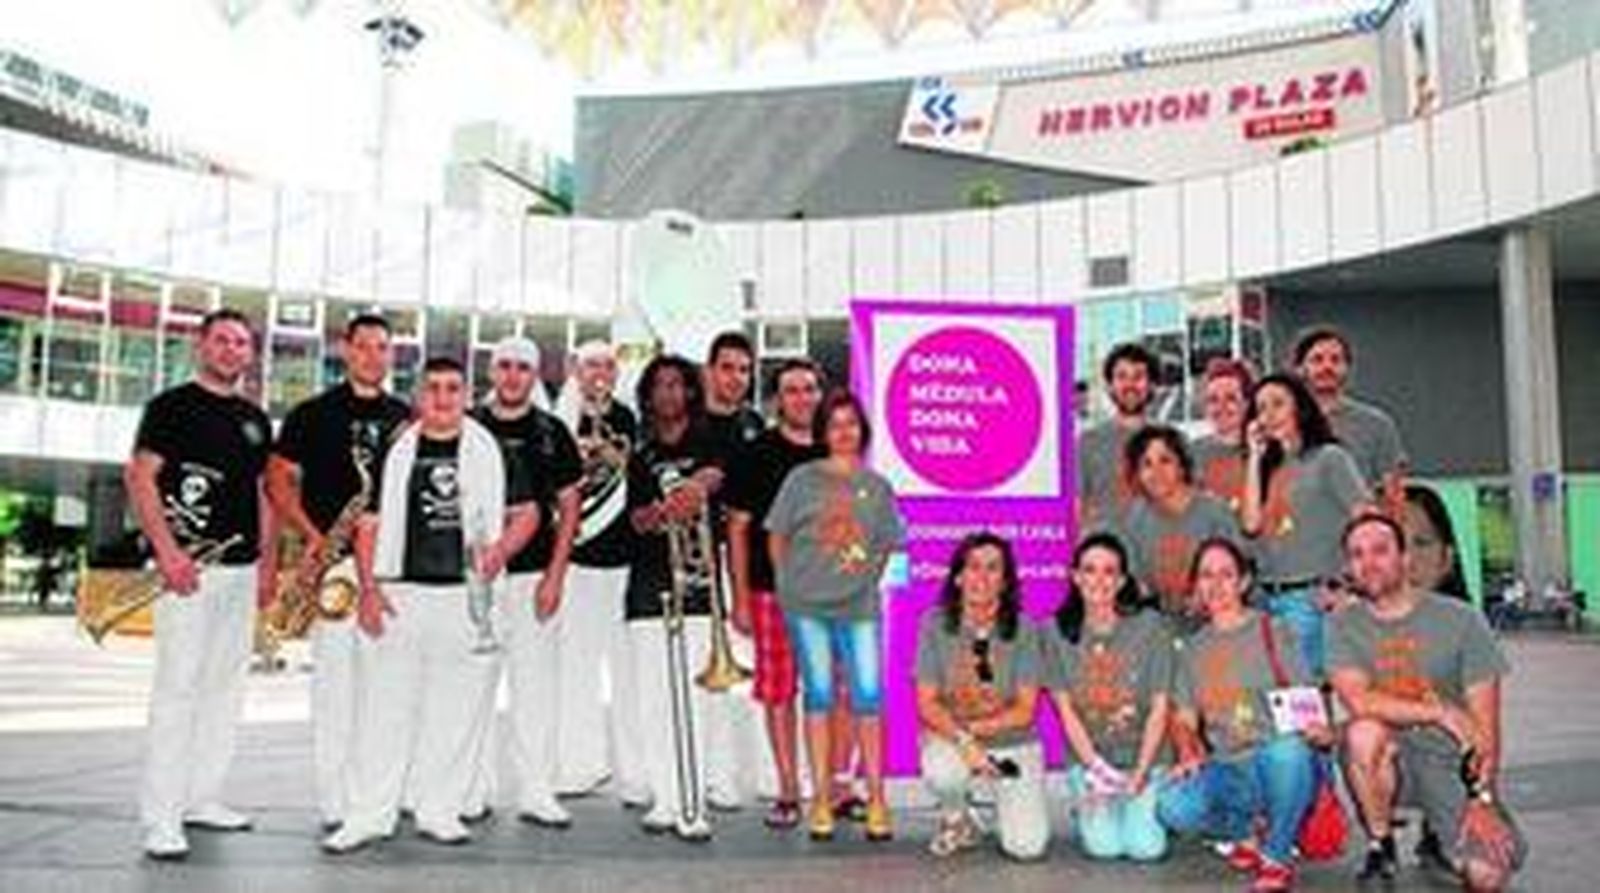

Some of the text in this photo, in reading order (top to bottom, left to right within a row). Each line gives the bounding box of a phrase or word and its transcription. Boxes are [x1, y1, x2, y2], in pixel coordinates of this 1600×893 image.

[1228, 69, 1368, 112] PLAZA
[909, 353, 977, 374] DONA
[910, 410, 979, 430] DONA
[910, 435, 971, 455] VIDA
